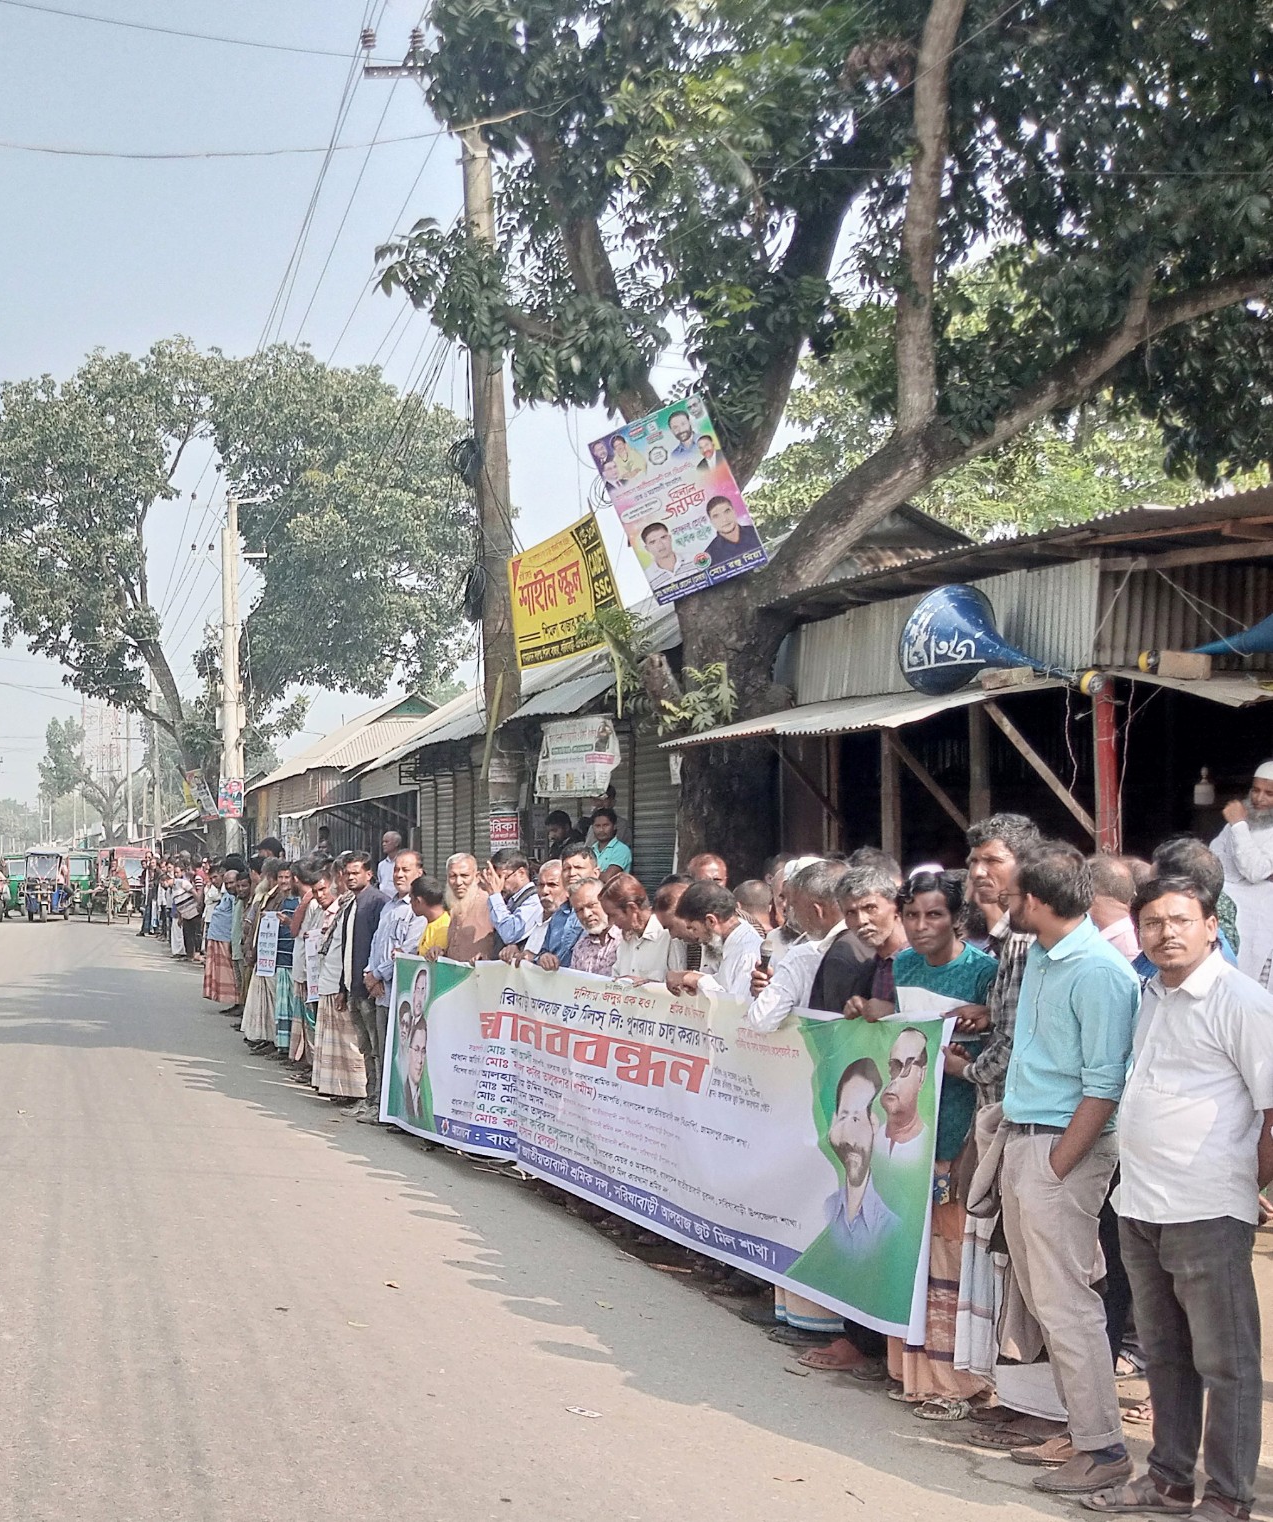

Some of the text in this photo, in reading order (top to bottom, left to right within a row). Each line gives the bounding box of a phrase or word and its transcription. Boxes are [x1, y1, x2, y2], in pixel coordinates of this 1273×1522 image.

[518, 560, 584, 616] শাহীন স্কুল
[594, 576, 612, 600] SSC
[490, 819, 517, 833] রিকা
[601, 992, 622, 1006] জদুর
[623, 995, 637, 1005] এক
[562, 1002, 579, 1023] জুট
[626, 1016, 656, 1037] পুনরায়
[678, 1026, 701, 1046] করার
[480, 1009, 709, 1094] মানববন্ধন
[485, 1056, 509, 1069] মোঃ
[478, 1080, 497, 1091] মোঃ
[476, 1090, 496, 1102] মোঃ
[476, 1103, 517, 1117] এ.কে.এ
[474, 1113, 499, 1125] মোঃ
[522, 1144, 569, 1175] জাতীয়তাবাদী
[570, 1165, 594, 1187] শ্রমিক
[594, 1175, 612, 1198] দল,
[613, 1184, 660, 1216] সরিষাবাড়ী
[661, 1203, 692, 1233] আলহাজ
[693, 1217, 711, 1242] জুট
[712, 1226, 737, 1250] মিল
